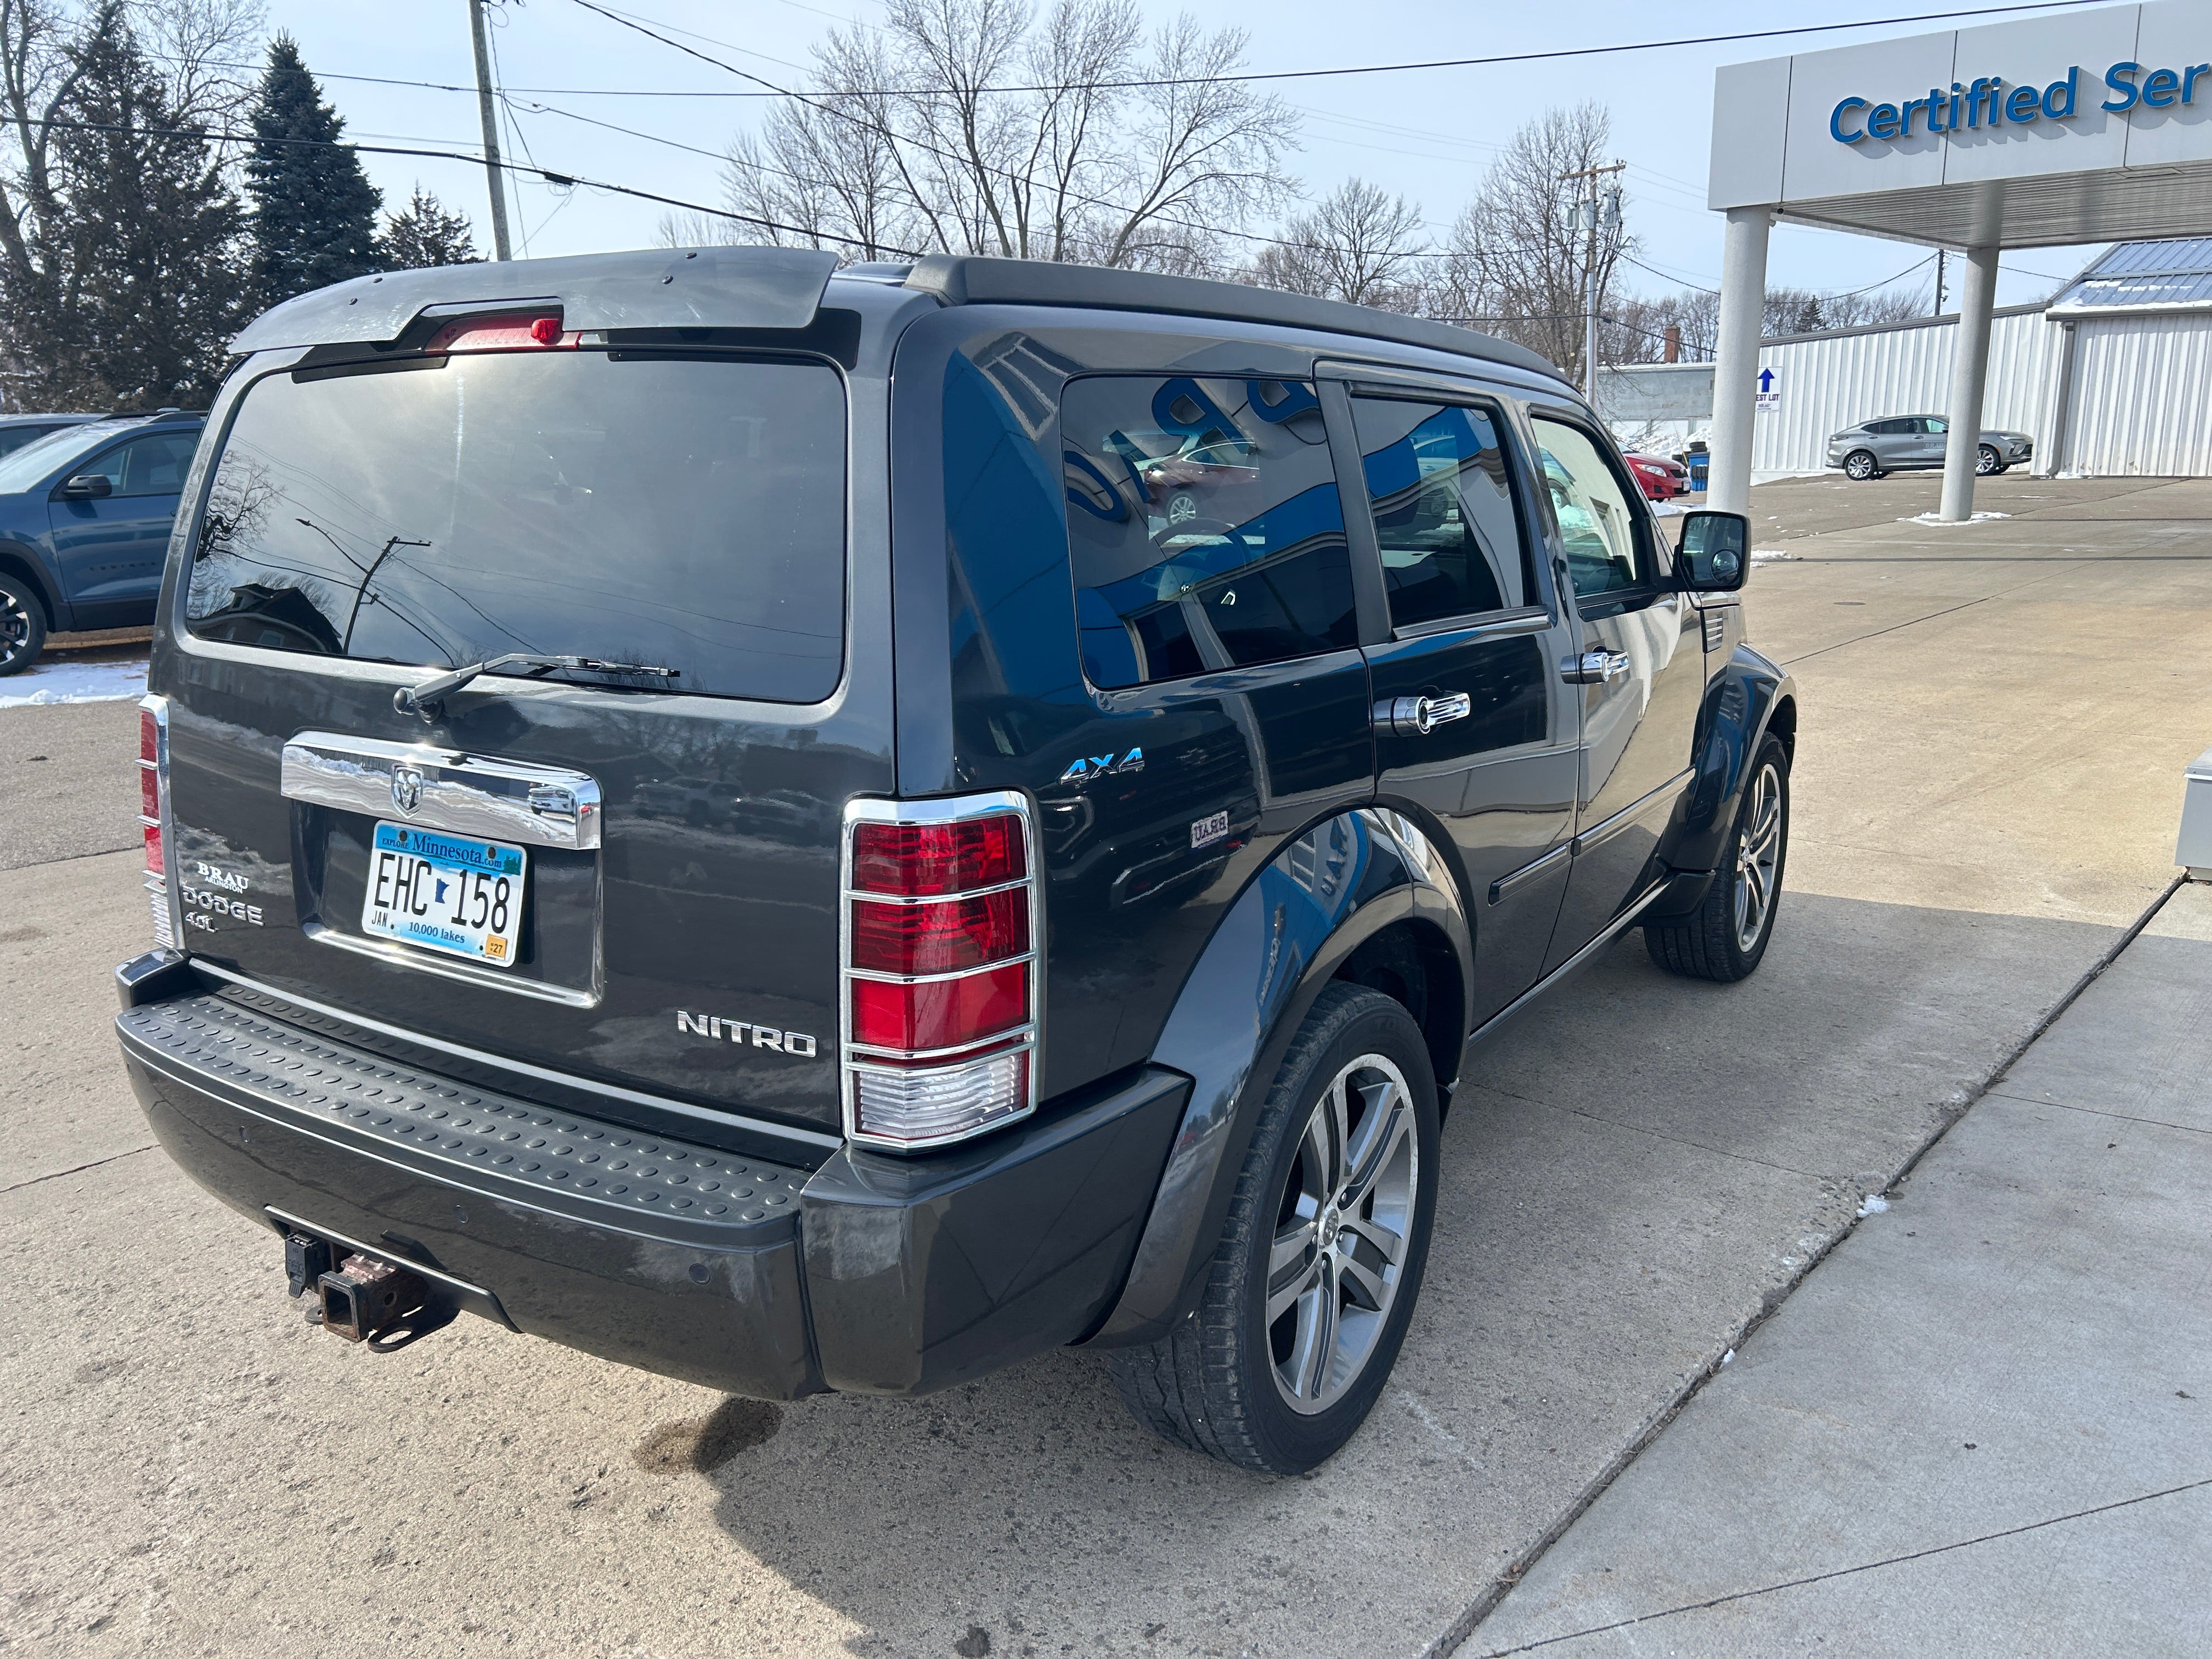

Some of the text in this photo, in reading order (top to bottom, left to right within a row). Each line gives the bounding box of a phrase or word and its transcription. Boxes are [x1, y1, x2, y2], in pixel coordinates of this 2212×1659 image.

[1830, 61, 2210, 144] Certified Ser
[382, 837, 409, 850] EXPLORE
[197, 861, 249, 890] BRAU
[205, 876, 244, 895] ARLINGTON
[374, 852, 510, 934] EHC 158
[182, 885, 266, 927] DODGE
[371, 910, 388, 928] JAN
[408, 922, 465, 944] 10,000 lakes
[493, 943, 503, 954] 27
[676, 1010, 819, 1058] NITRO
